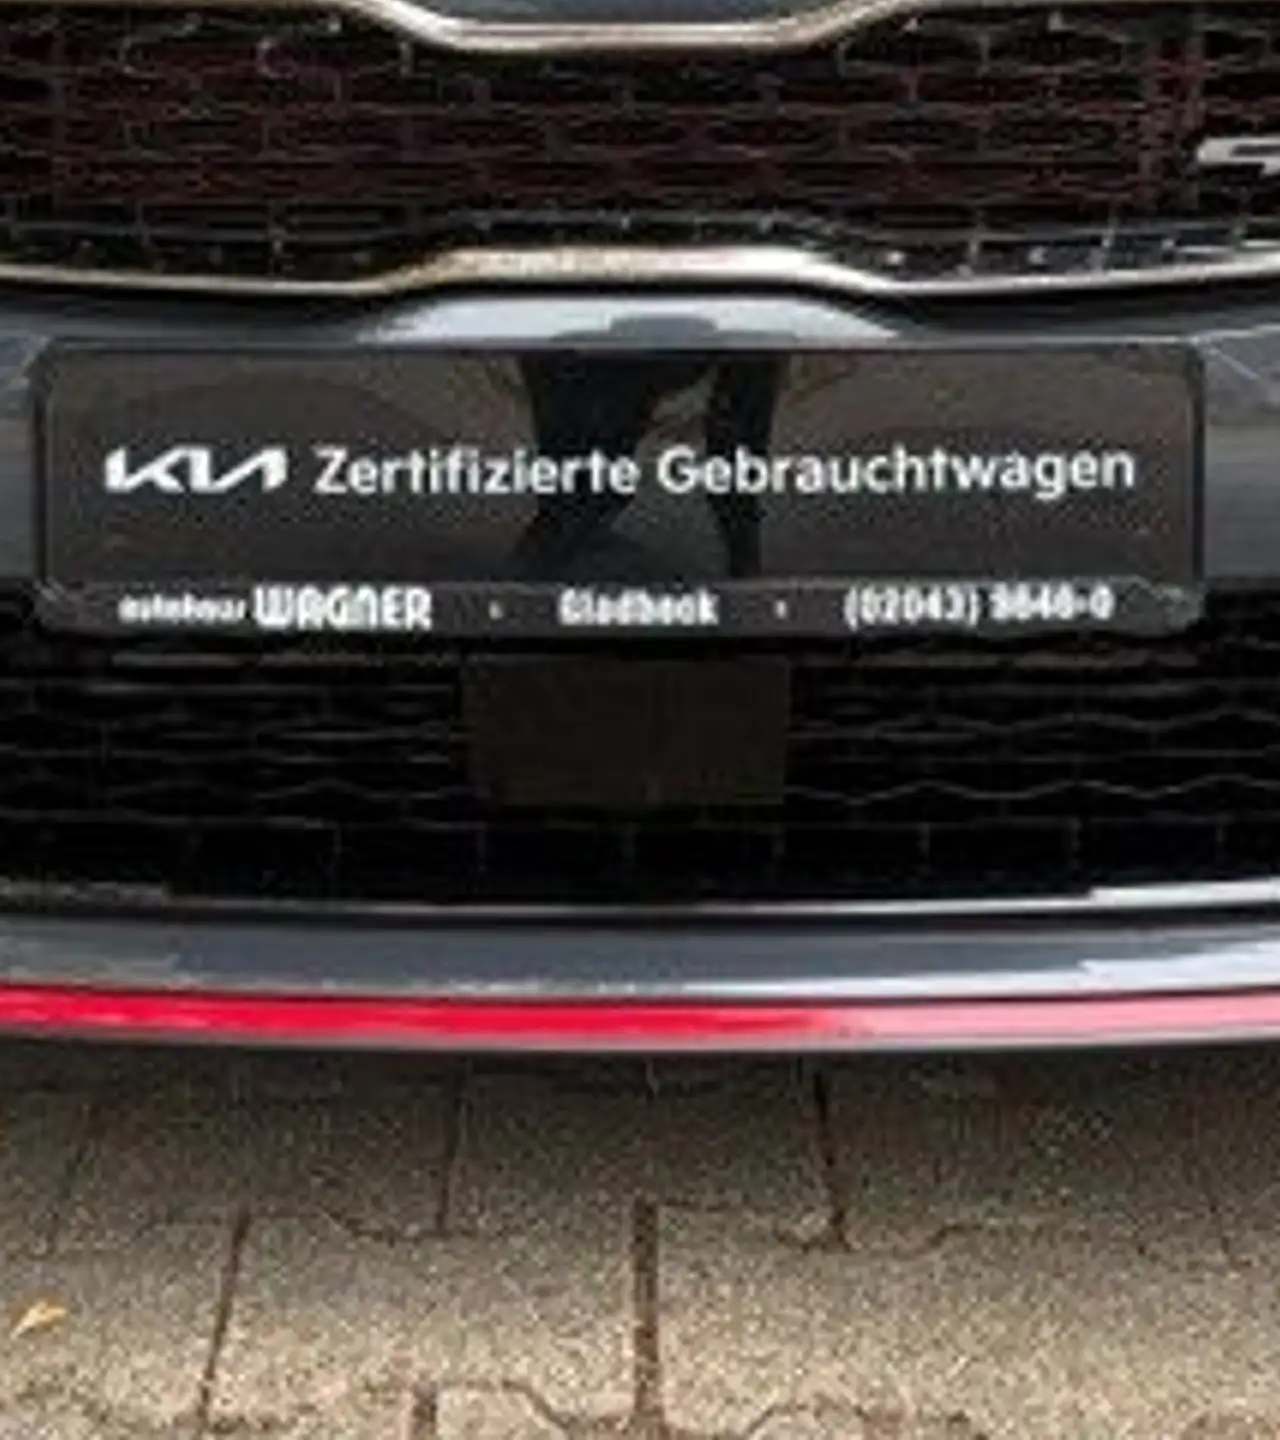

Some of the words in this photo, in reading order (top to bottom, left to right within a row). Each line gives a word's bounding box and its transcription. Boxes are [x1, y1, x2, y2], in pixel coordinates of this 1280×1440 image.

[105, 444, 287, 494] KIA
[313, 445, 640, 494] Zertifizierte
[656, 444, 1136, 500] Gebrauchtwagen
[253, 584, 433, 631] WAGNER
